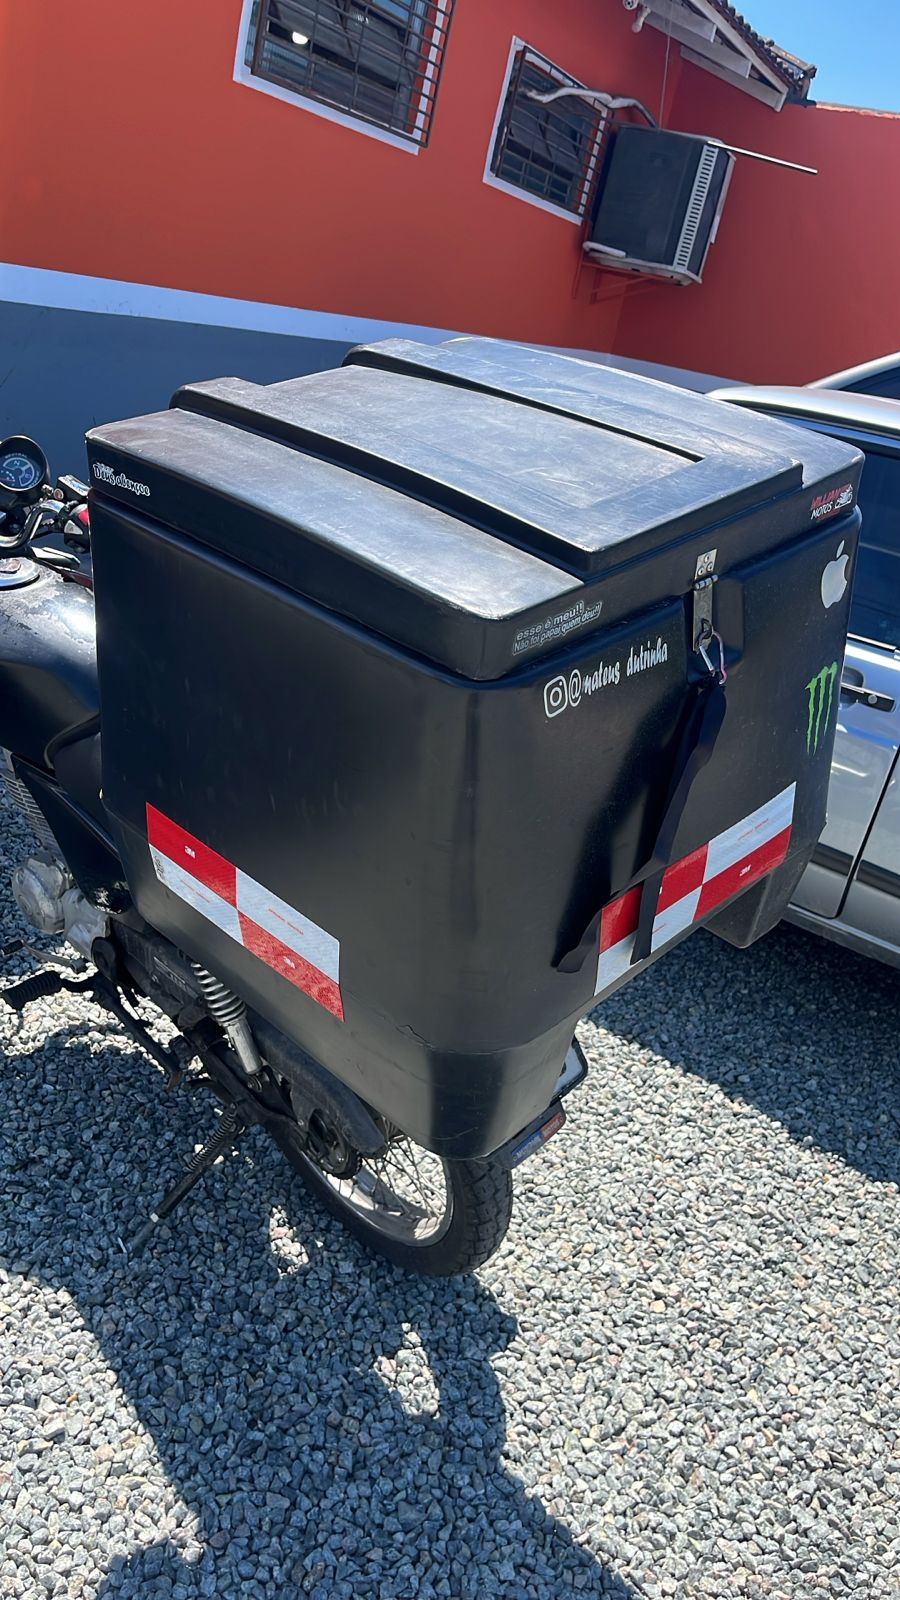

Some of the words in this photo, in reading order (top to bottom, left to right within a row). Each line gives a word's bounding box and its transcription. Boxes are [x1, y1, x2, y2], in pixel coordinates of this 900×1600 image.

[516, 625, 542, 641] esse
[513, 640, 529, 652] Não
[530, 634, 540, 645] foi
[184, 845, 196, 859] 3M
[740, 863, 752, 877] 3M
